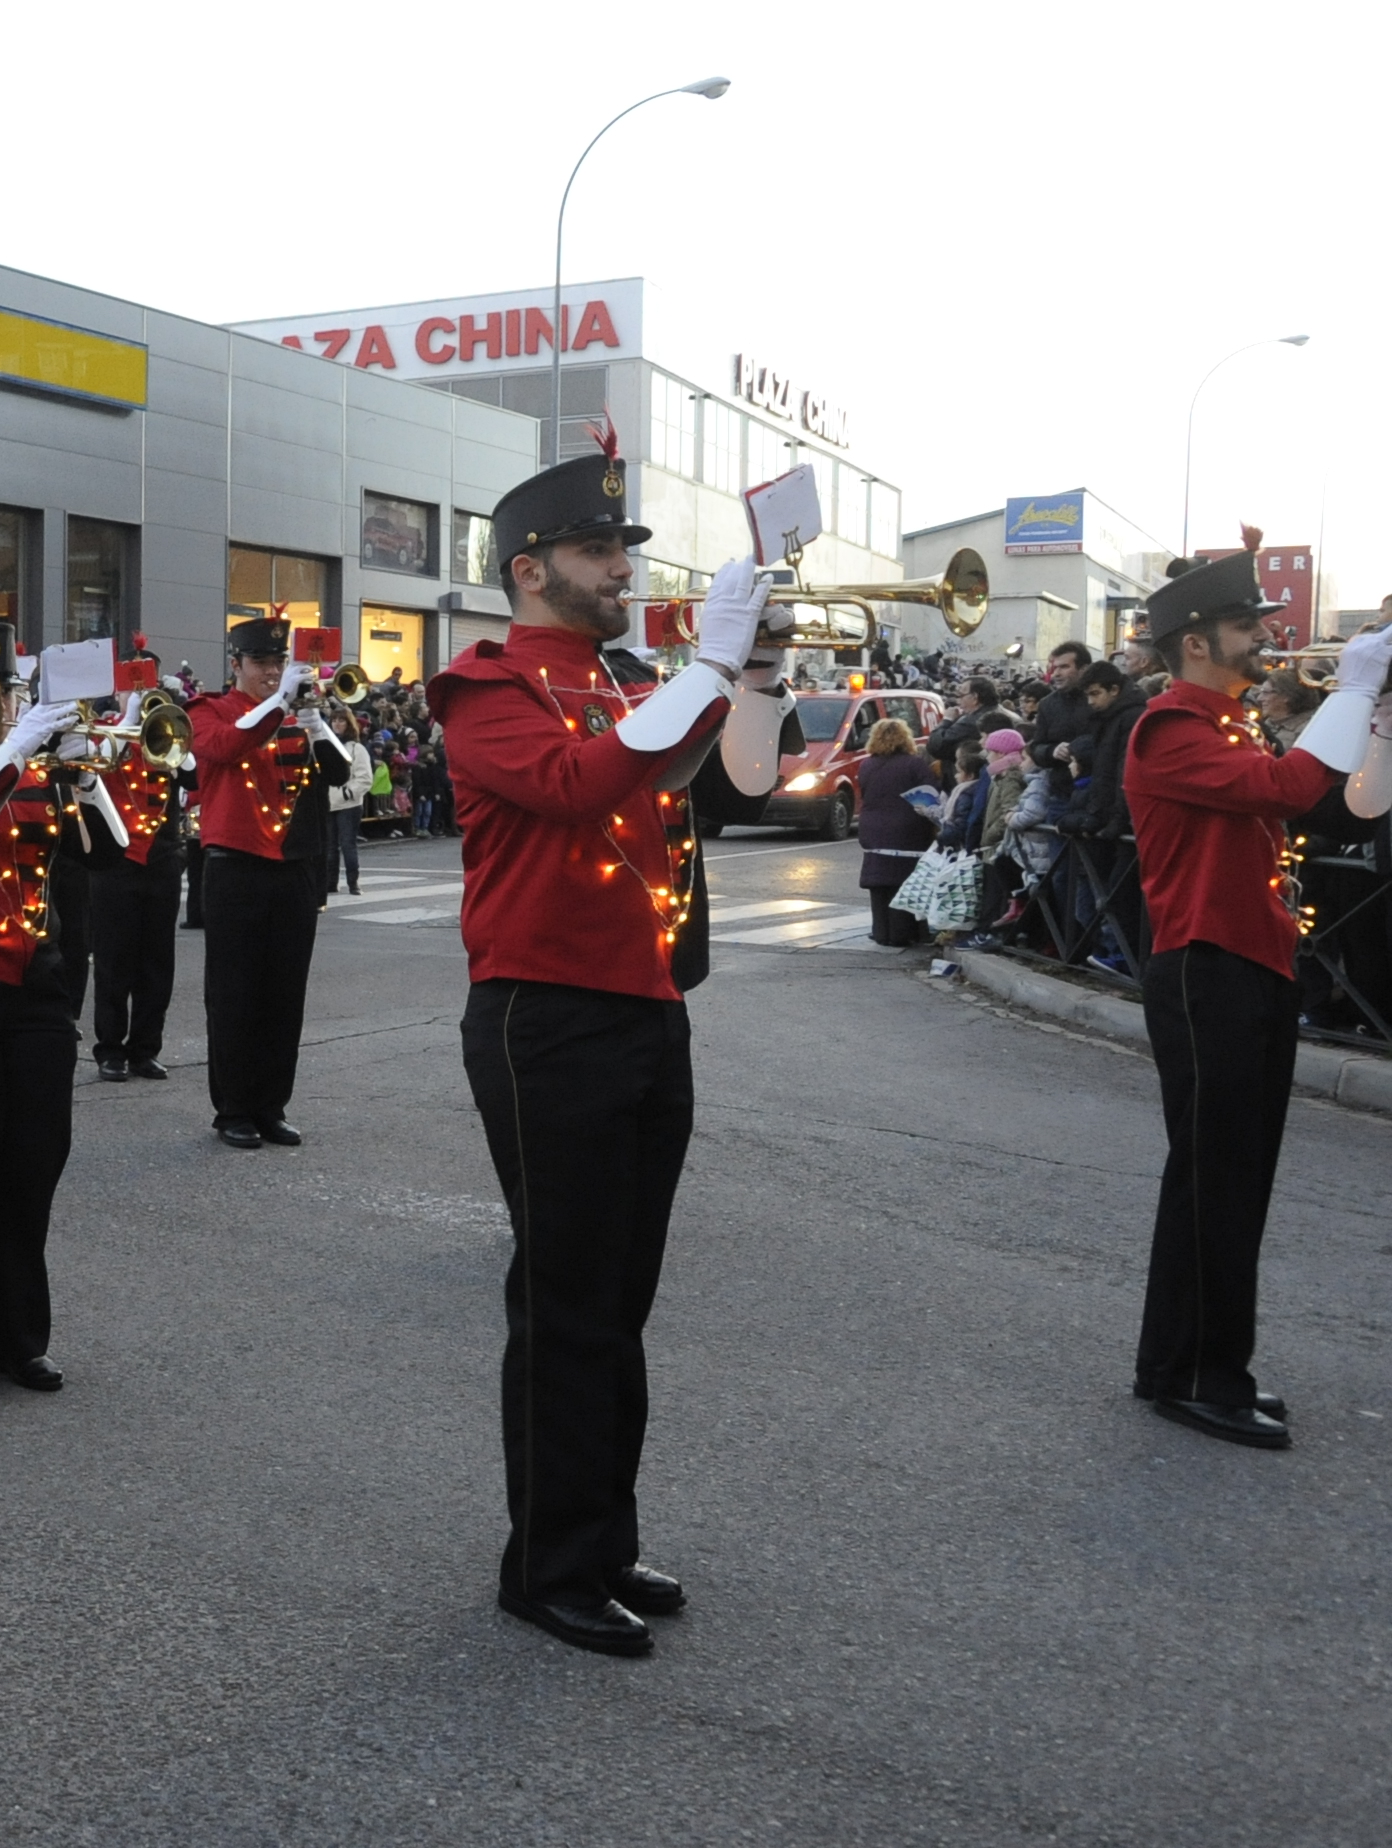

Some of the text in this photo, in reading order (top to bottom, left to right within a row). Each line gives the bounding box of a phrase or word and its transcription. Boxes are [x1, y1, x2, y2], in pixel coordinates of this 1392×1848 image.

[414, 299, 621, 365] CHINA
[730, 352, 851, 450] PLAZA CHINA
